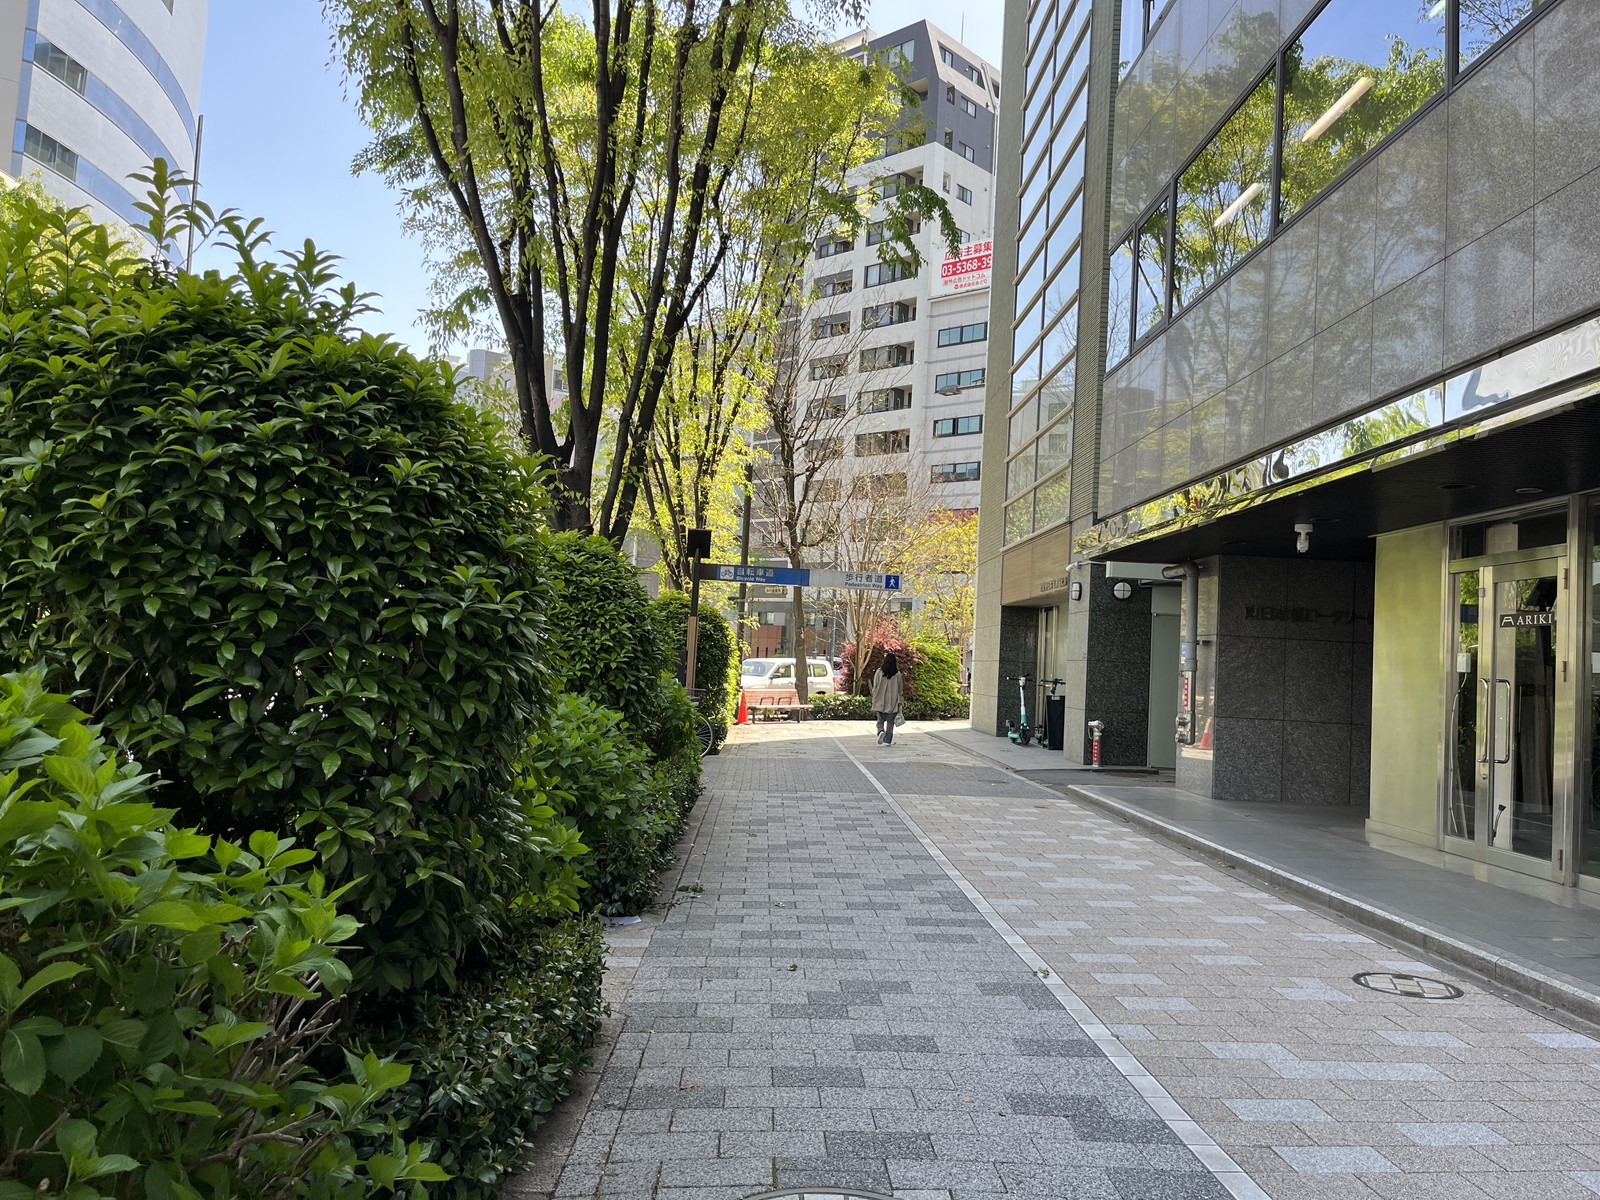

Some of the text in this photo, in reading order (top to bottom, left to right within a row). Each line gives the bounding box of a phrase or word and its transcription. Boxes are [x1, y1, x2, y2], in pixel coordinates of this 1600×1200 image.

[737, 567, 774, 577] 自転車道
[845, 573, 883, 583] 歩行者道
[1516, 613, 1553, 625] ARIKI
